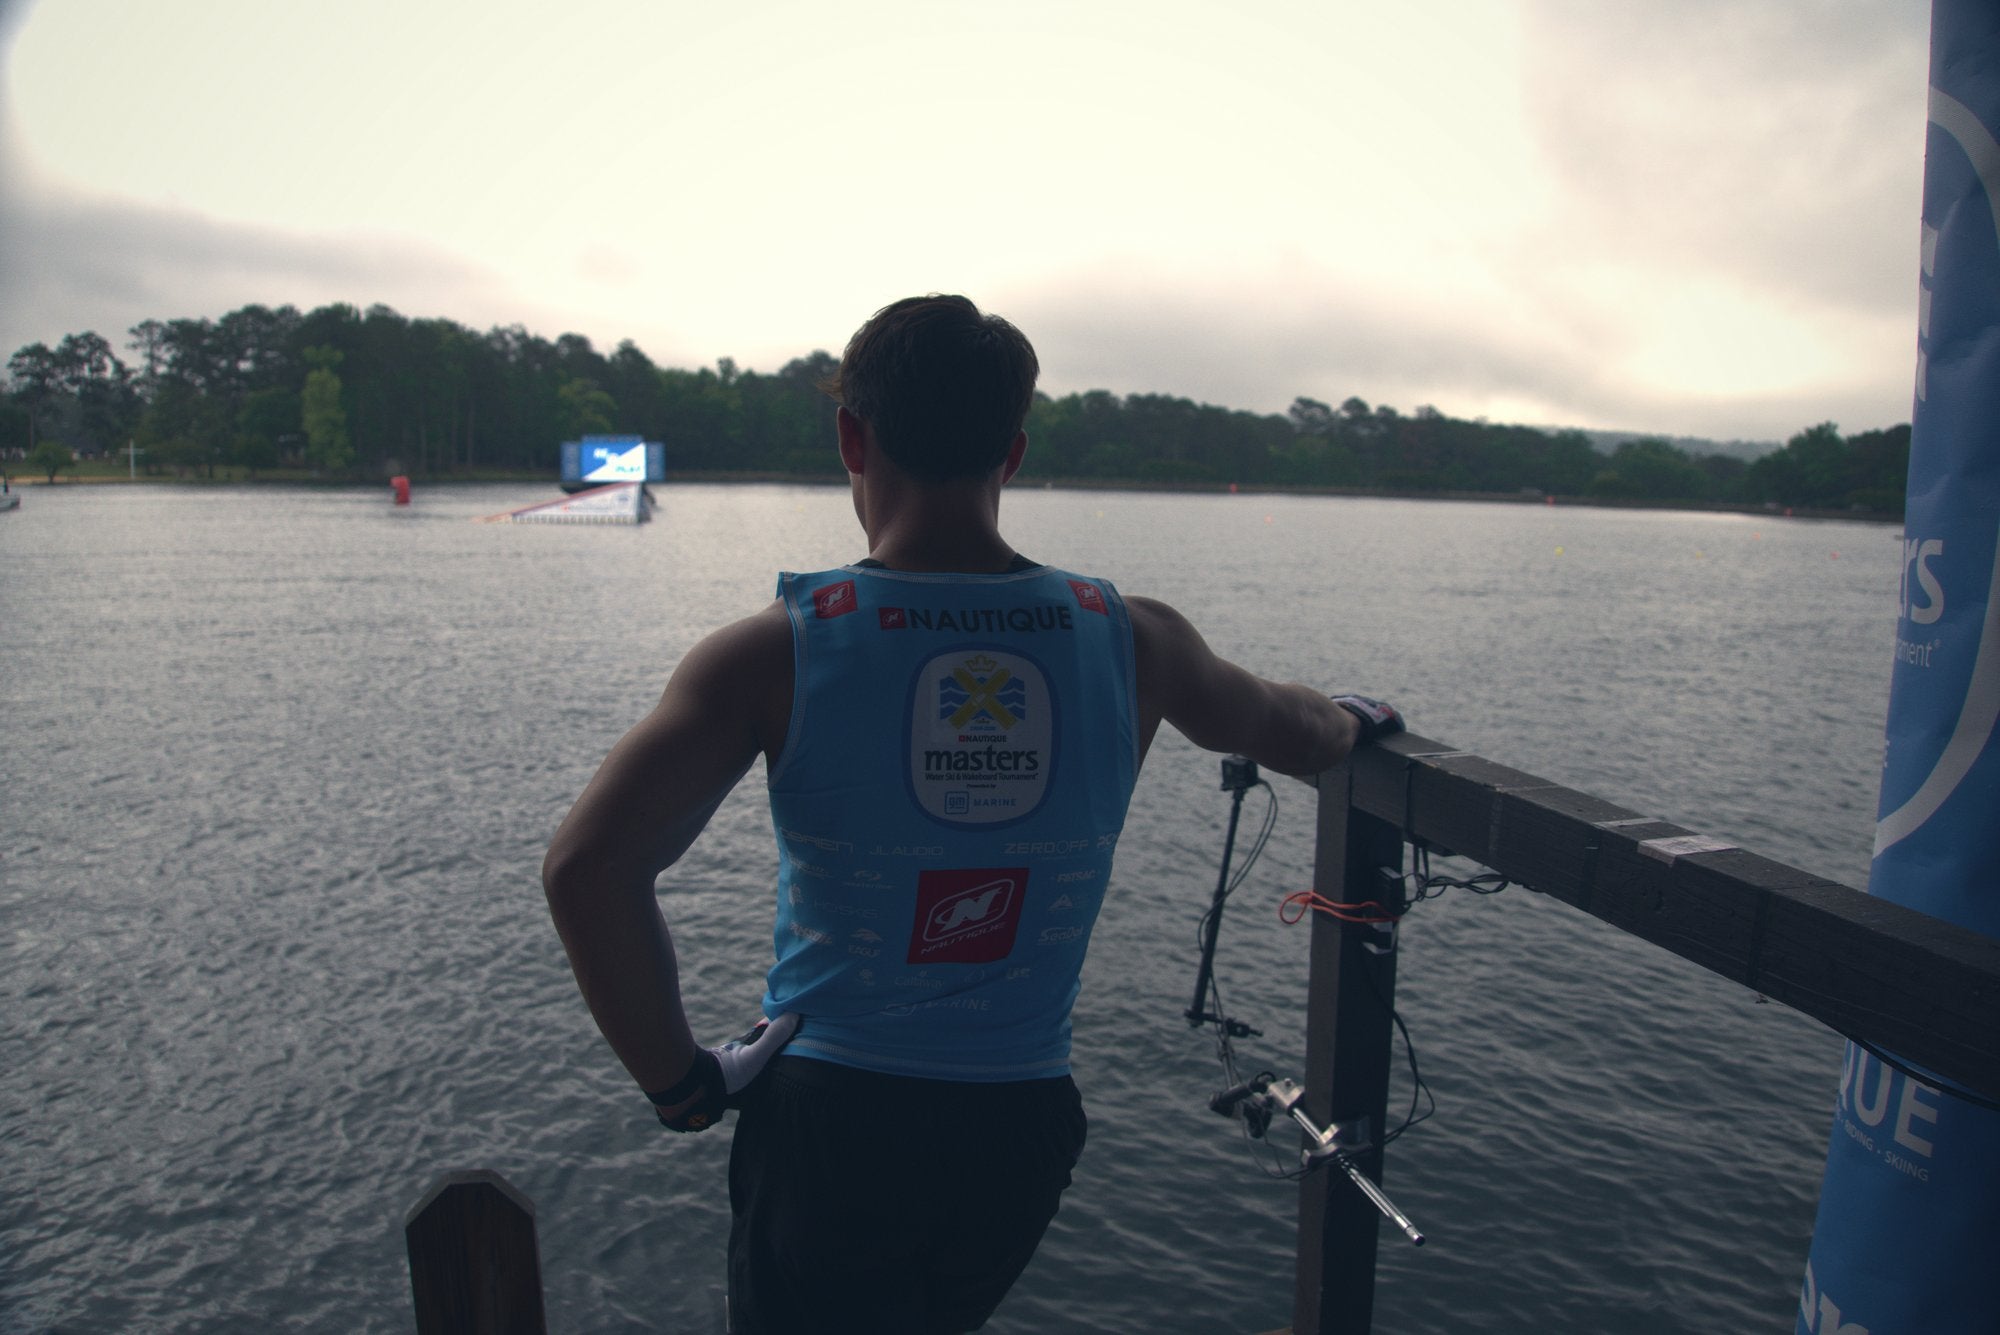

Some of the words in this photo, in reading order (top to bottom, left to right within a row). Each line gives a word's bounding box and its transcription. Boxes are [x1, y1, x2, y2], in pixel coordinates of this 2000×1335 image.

[908, 605, 1074, 632] NAUTIQUE
[965, 735, 1007, 743] NAUTIQUE
[924, 745, 1039, 771] masters
[925, 773, 944, 781] Water
[945, 773, 955, 781] Ski
[962, 773, 997, 781] Wakeboard
[973, 798, 1017, 807] MARINE
[893, 845, 944, 856] AUDIO
[1885, 1150, 1929, 1183] SKIING
